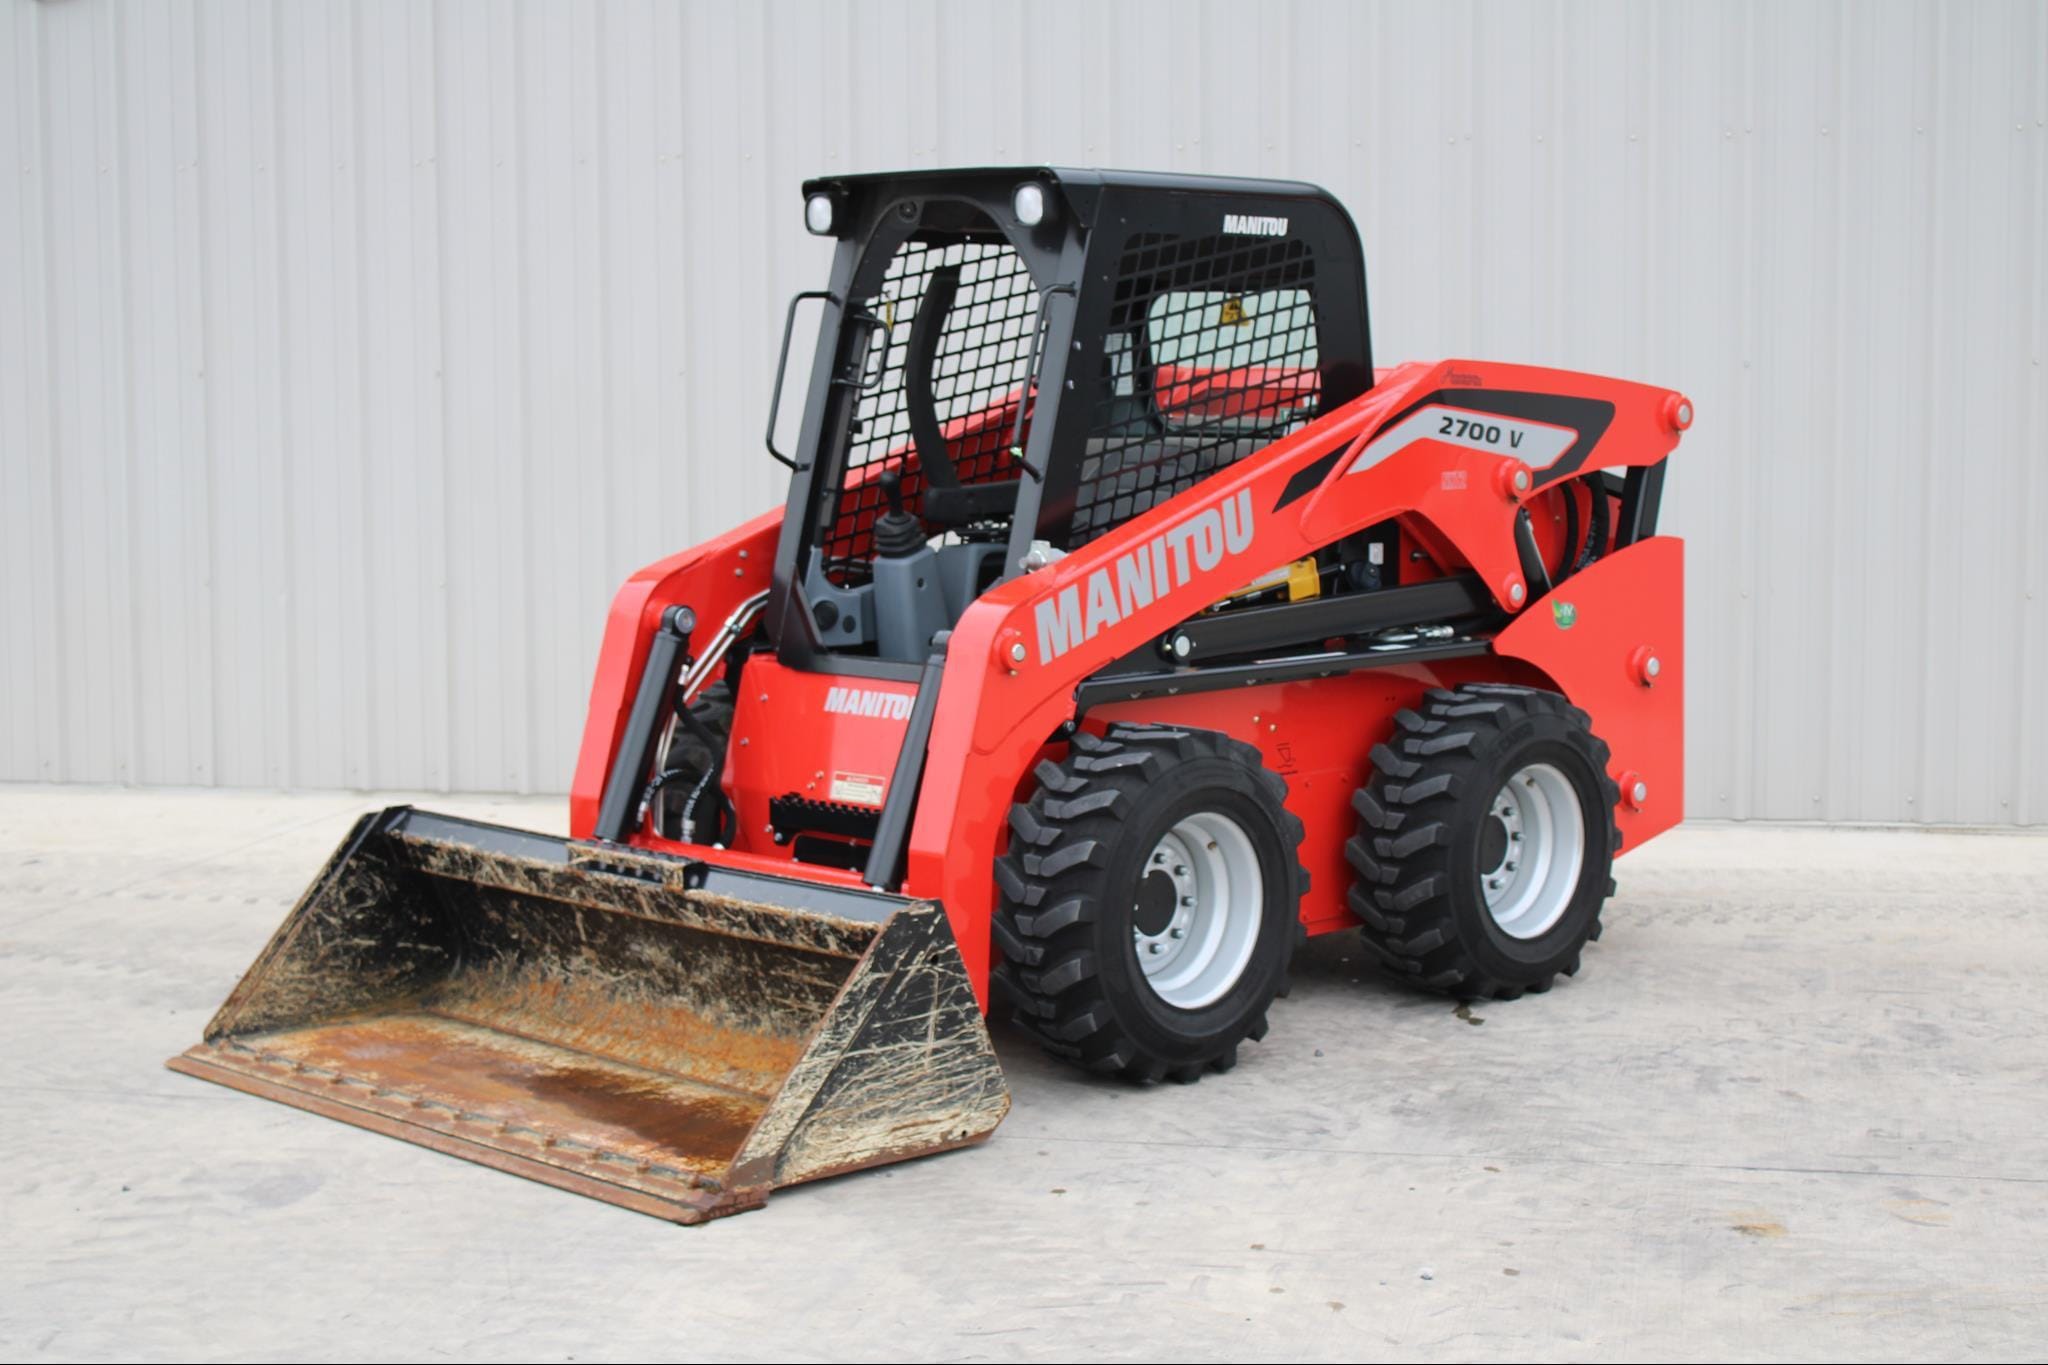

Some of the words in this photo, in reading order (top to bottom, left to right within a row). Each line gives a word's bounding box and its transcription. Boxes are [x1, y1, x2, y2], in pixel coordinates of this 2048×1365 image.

[1223, 214, 1288, 236] MANITOU
[1439, 416, 1500, 444] 2700
[1510, 430, 1523, 448] V
[1034, 487, 1254, 666] MANITOU
